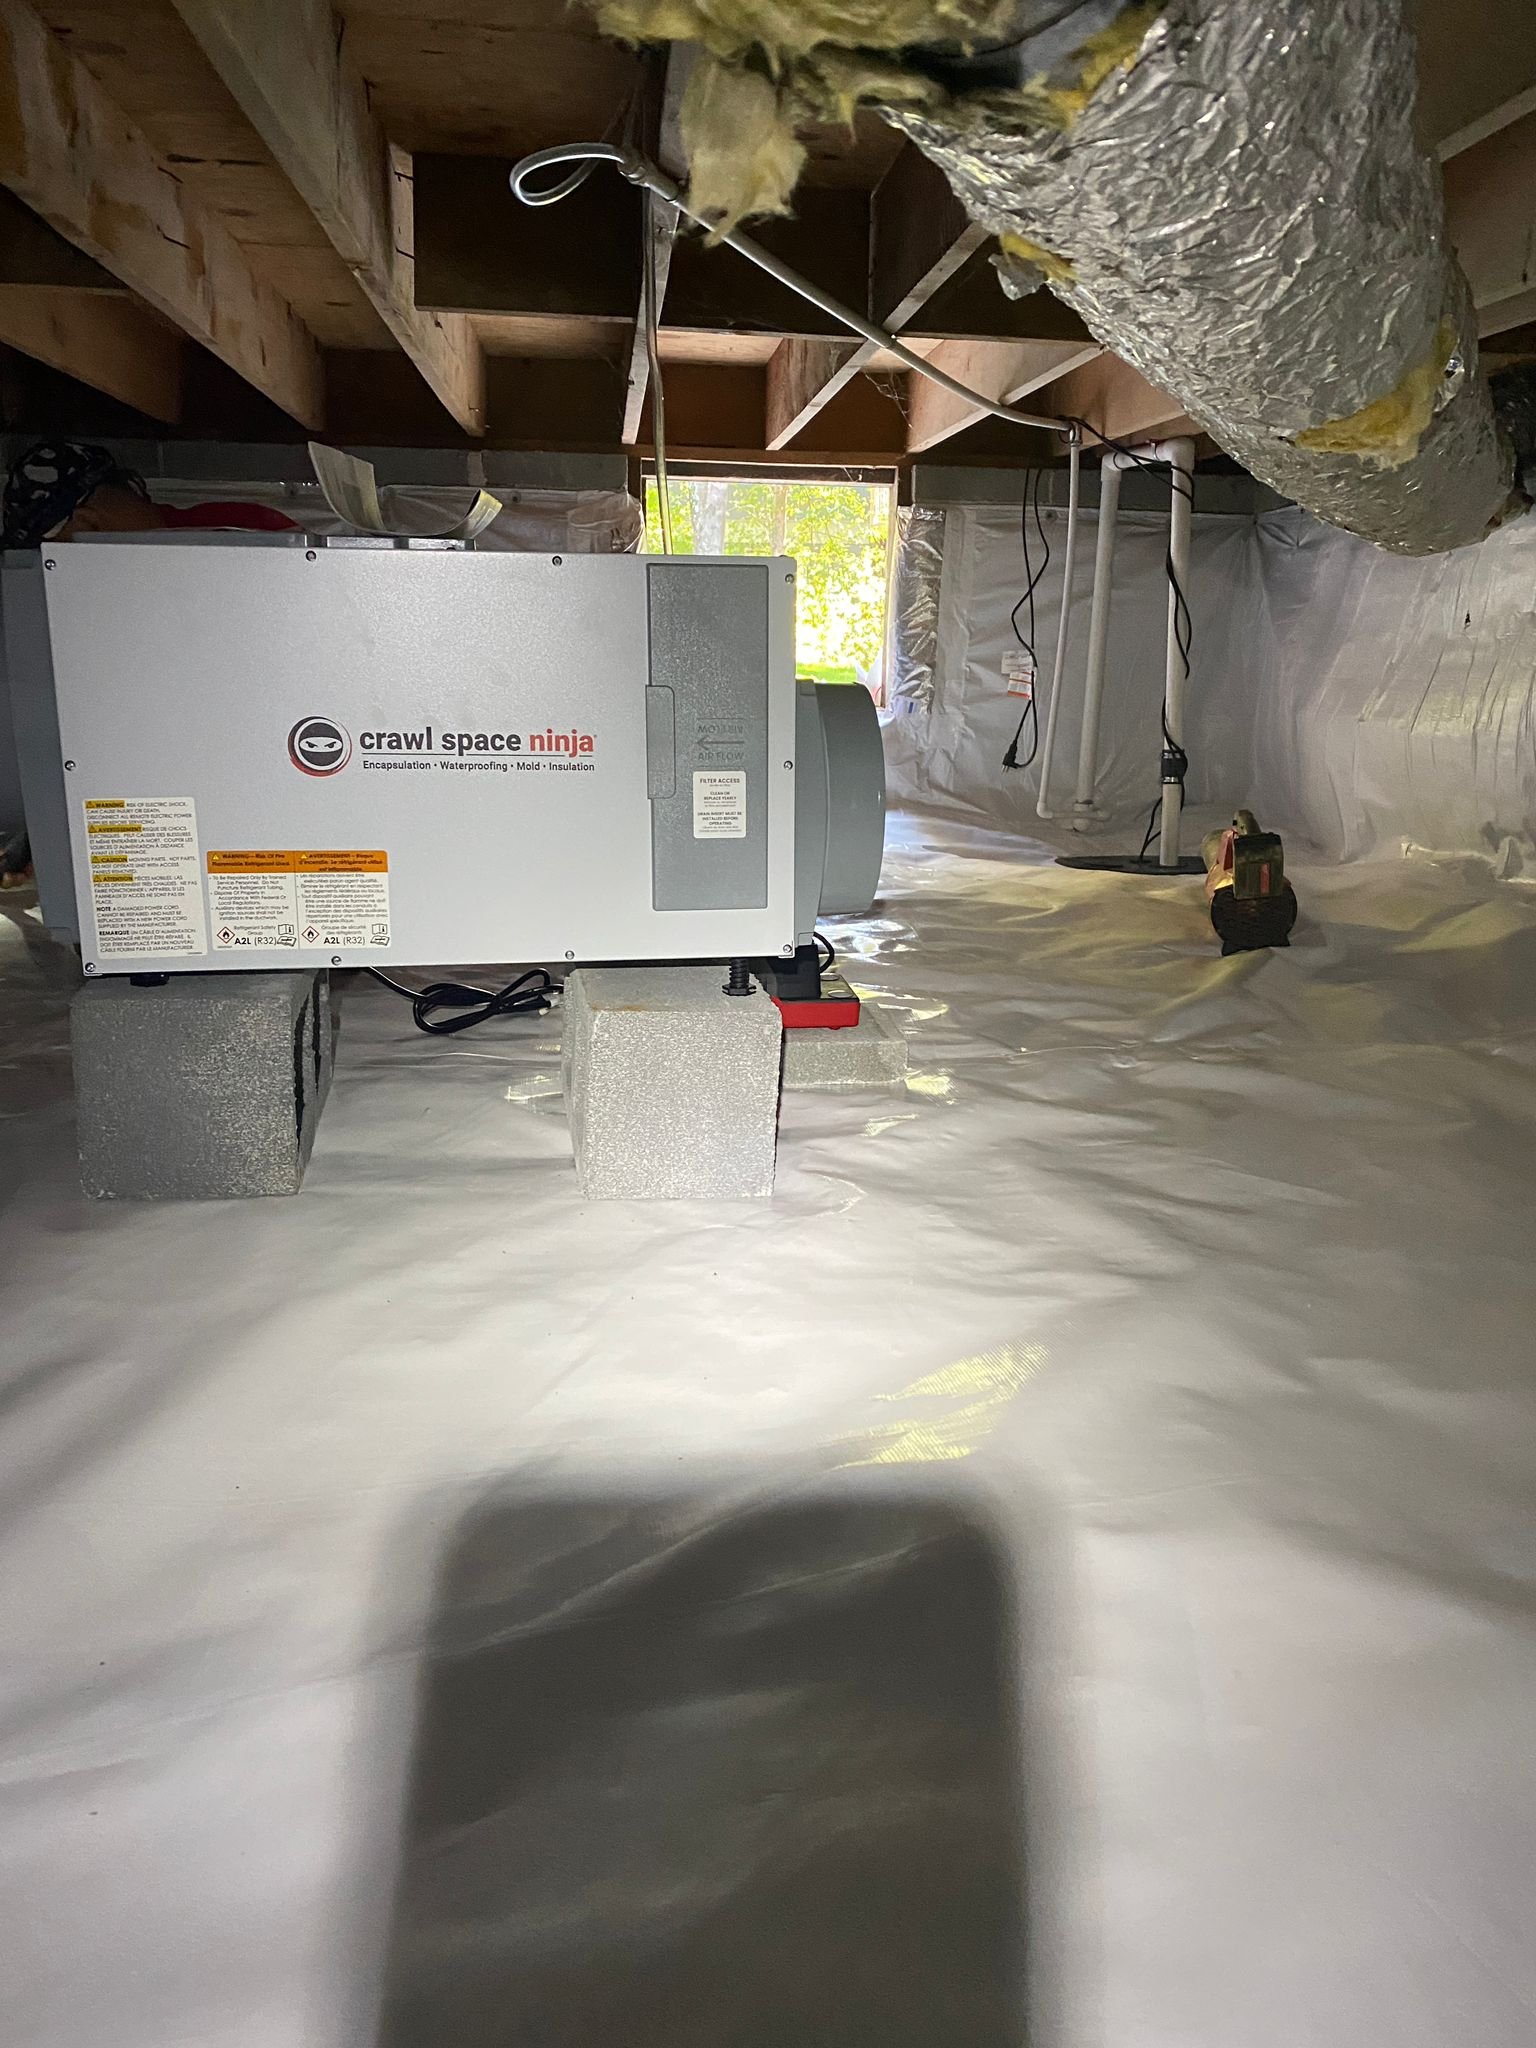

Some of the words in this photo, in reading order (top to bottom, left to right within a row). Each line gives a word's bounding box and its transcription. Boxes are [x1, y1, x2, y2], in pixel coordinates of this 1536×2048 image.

[360, 726, 432, 750] crawl
[442, 733, 522, 756] space
[530, 728, 594, 758] ninja
[698, 752, 714, 760] AIR
[716, 752, 744, 760] FLOW
[363, 760, 431, 771] Encapsulation
[440, 761, 508, 772] Waterproofing
[517, 762, 540, 770] Mold
[550, 762, 594, 771] Insulation
[234, 937, 252, 945] A2L
[254, 936, 277, 946] (R32)
[324, 936, 340, 944] A2L
[344, 936, 366, 946] (R32)
